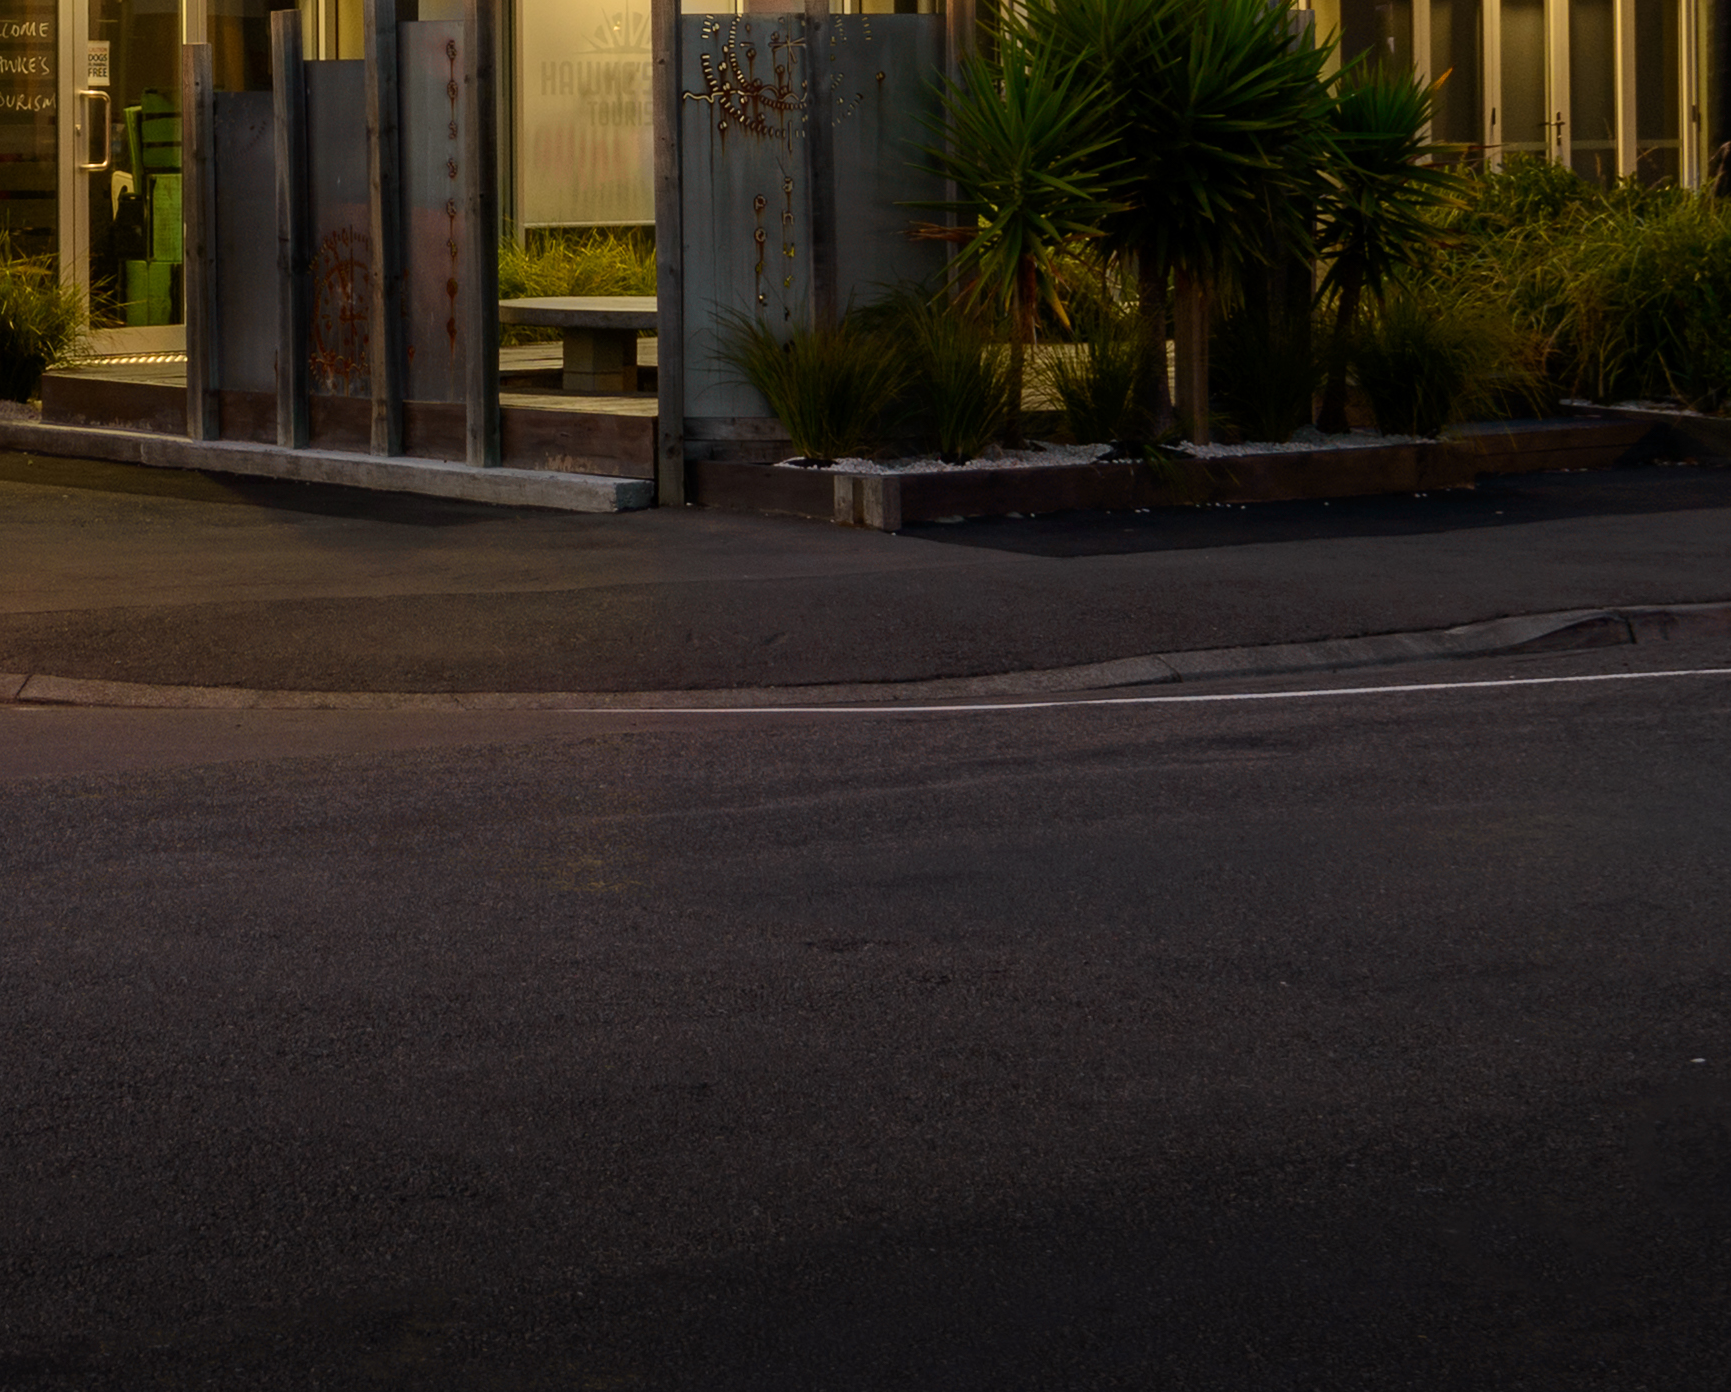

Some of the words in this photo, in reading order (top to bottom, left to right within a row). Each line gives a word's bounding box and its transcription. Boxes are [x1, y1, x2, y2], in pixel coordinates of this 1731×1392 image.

[88, 53, 108, 62] DOGS
[88, 67, 108, 77] FREE
[587, 101, 653, 127] TOURIS
